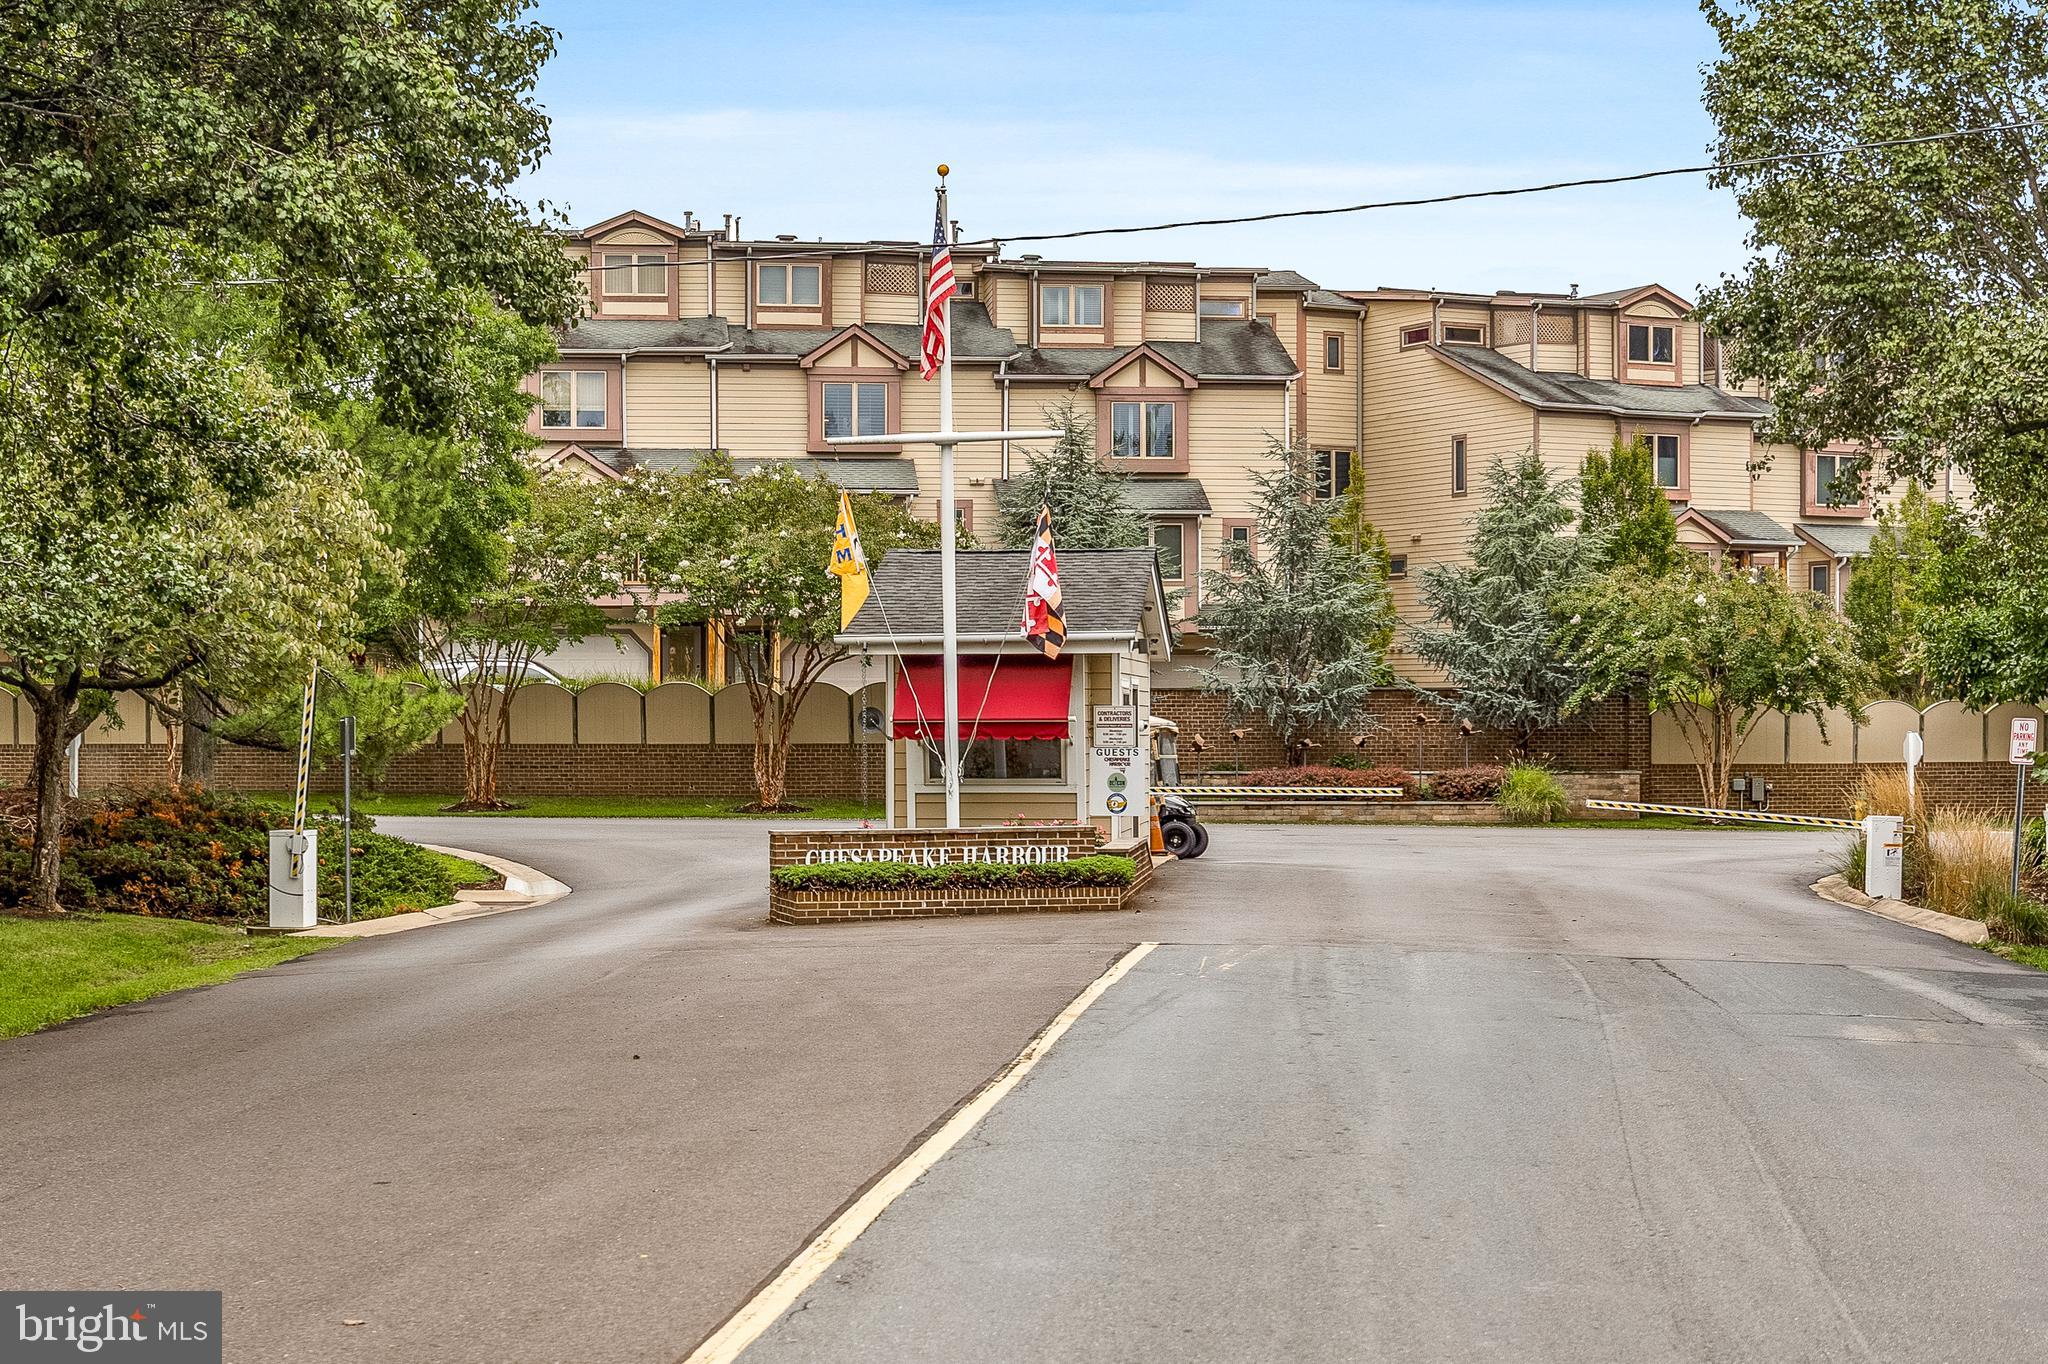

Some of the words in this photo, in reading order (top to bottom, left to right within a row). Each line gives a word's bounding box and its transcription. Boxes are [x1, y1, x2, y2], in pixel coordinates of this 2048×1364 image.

[2020, 722, 2029, 731] NO
[2013, 732, 2034, 740] PARKING
[1096, 748, 1139, 756] GUESTS
[805, 848, 951, 867] CHESAPEAKE
[962, 845, 1070, 865] HARBOUR
